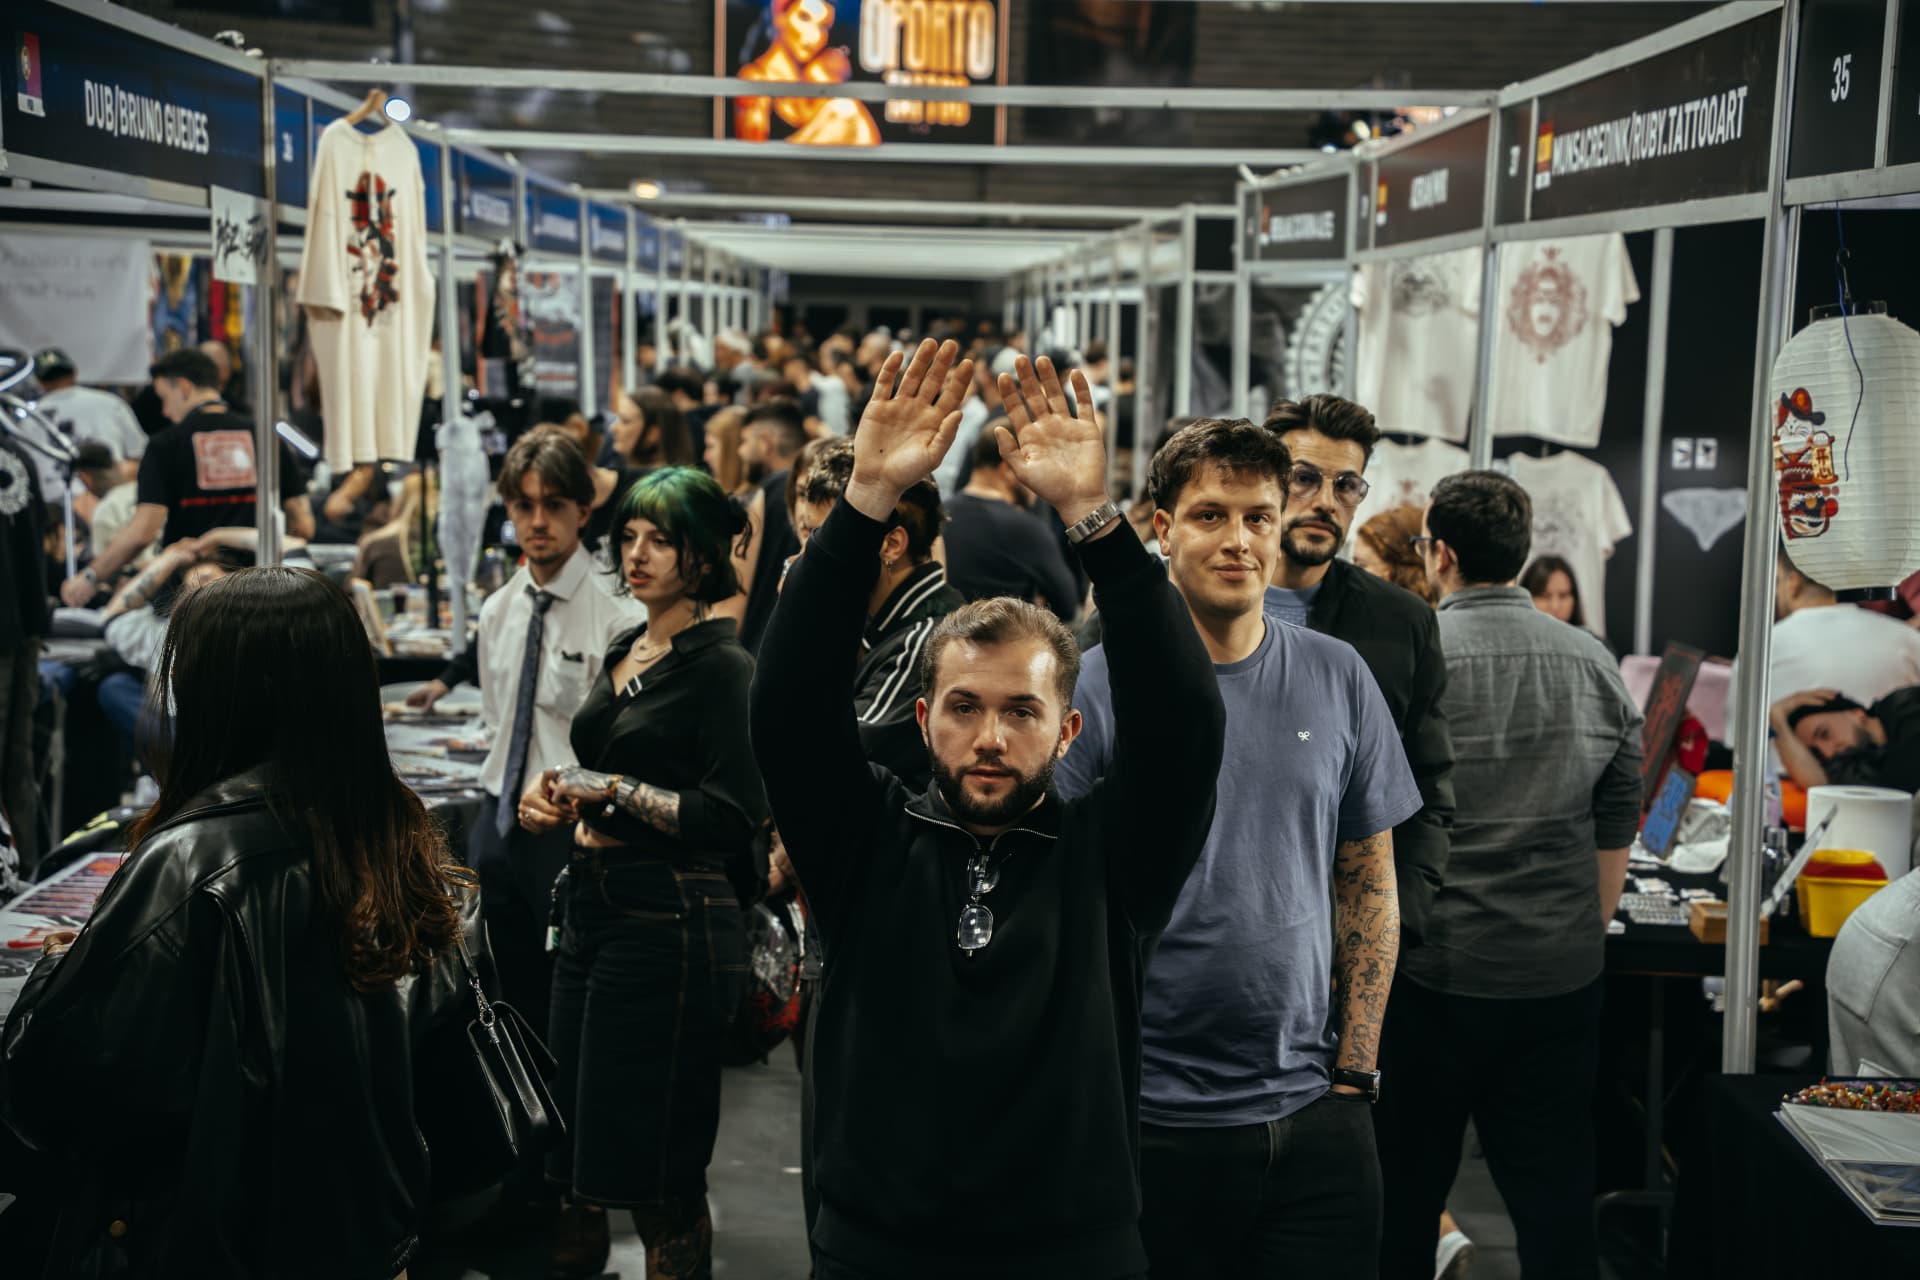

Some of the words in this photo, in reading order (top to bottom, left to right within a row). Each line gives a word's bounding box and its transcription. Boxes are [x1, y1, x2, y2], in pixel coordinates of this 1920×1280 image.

[1831, 53, 1852, 102] 35
[83, 79, 163, 144] DUB/BRUNO
[164, 104, 209, 155] GUEDES
